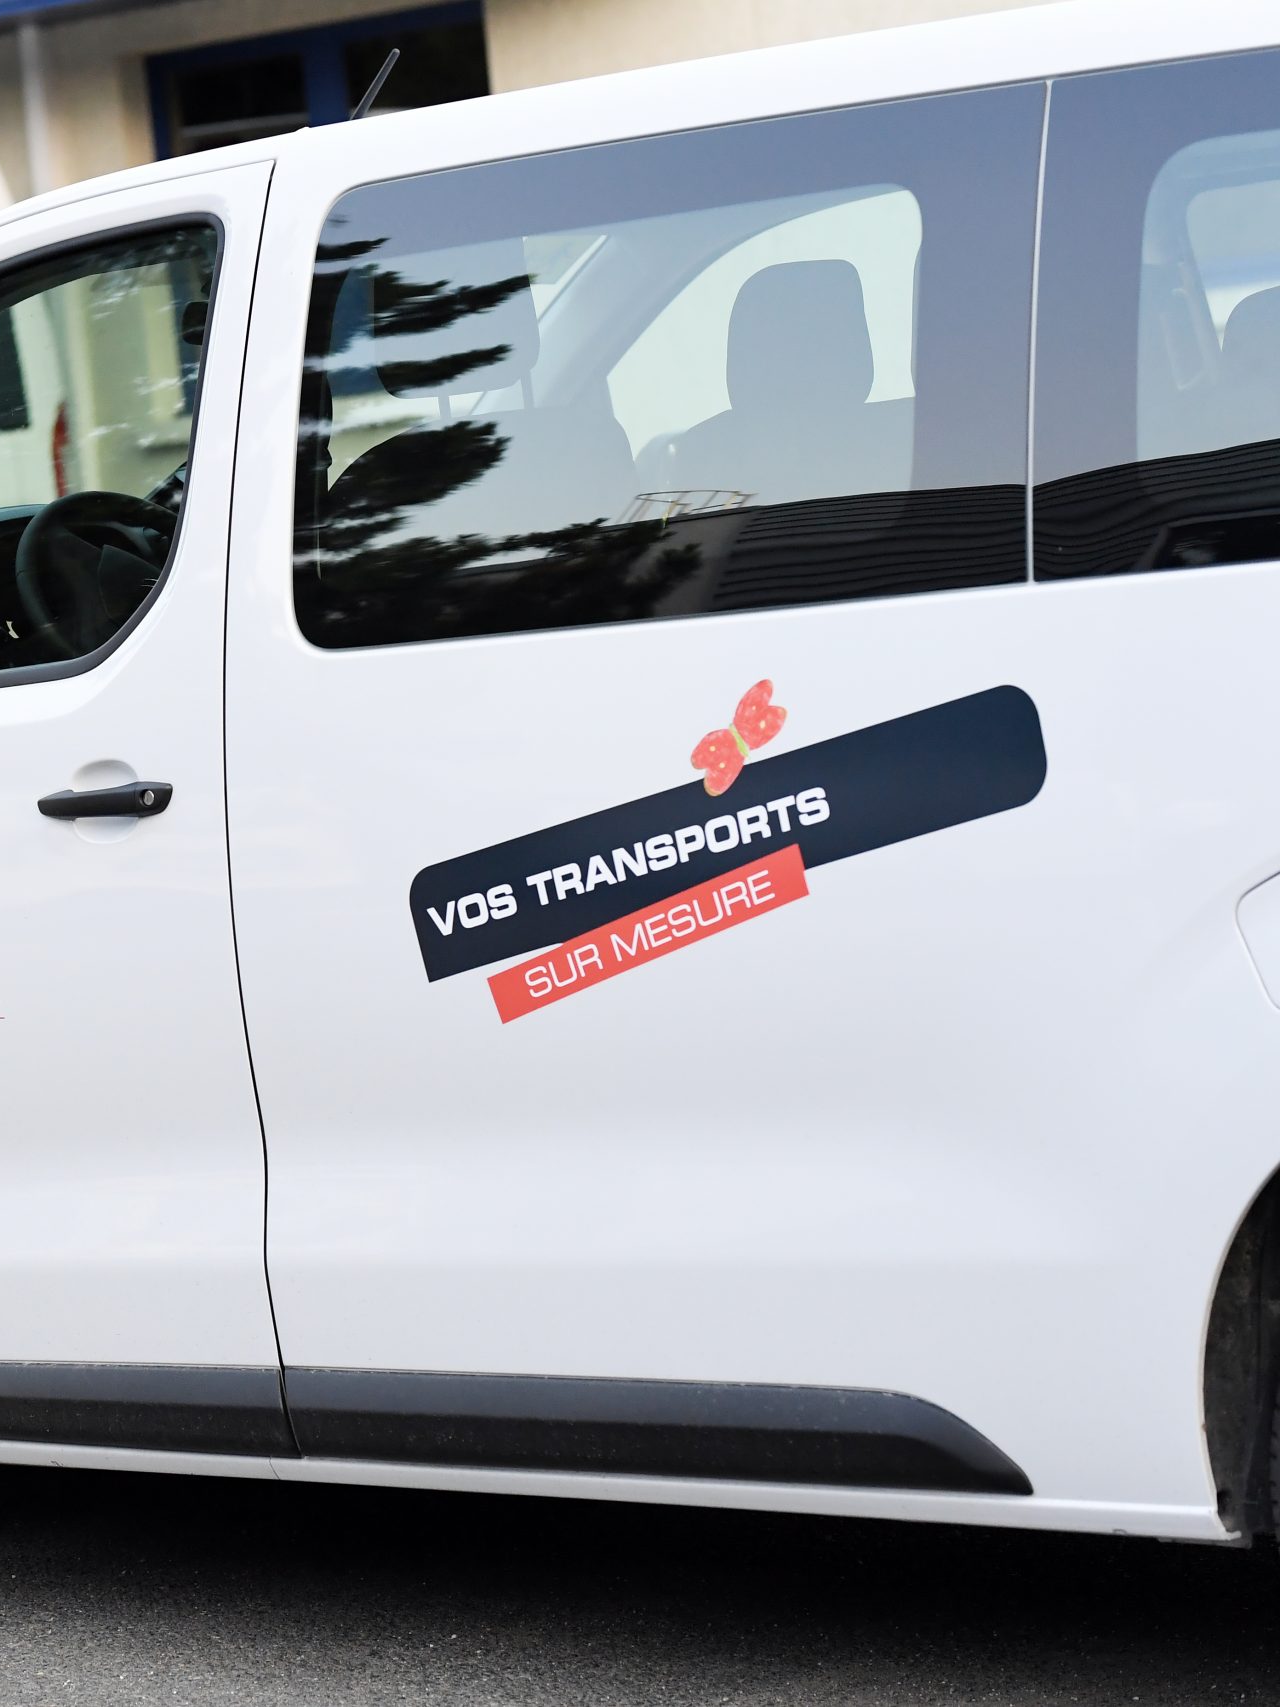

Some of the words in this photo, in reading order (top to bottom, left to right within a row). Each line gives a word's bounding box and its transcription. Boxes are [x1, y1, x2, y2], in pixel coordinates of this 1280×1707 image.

[427, 884, 518, 936] VOS
[526, 787, 830, 906] TRANSPORTS
[525, 944, 603, 998] SUR
[610, 870, 775, 961] MESURE
